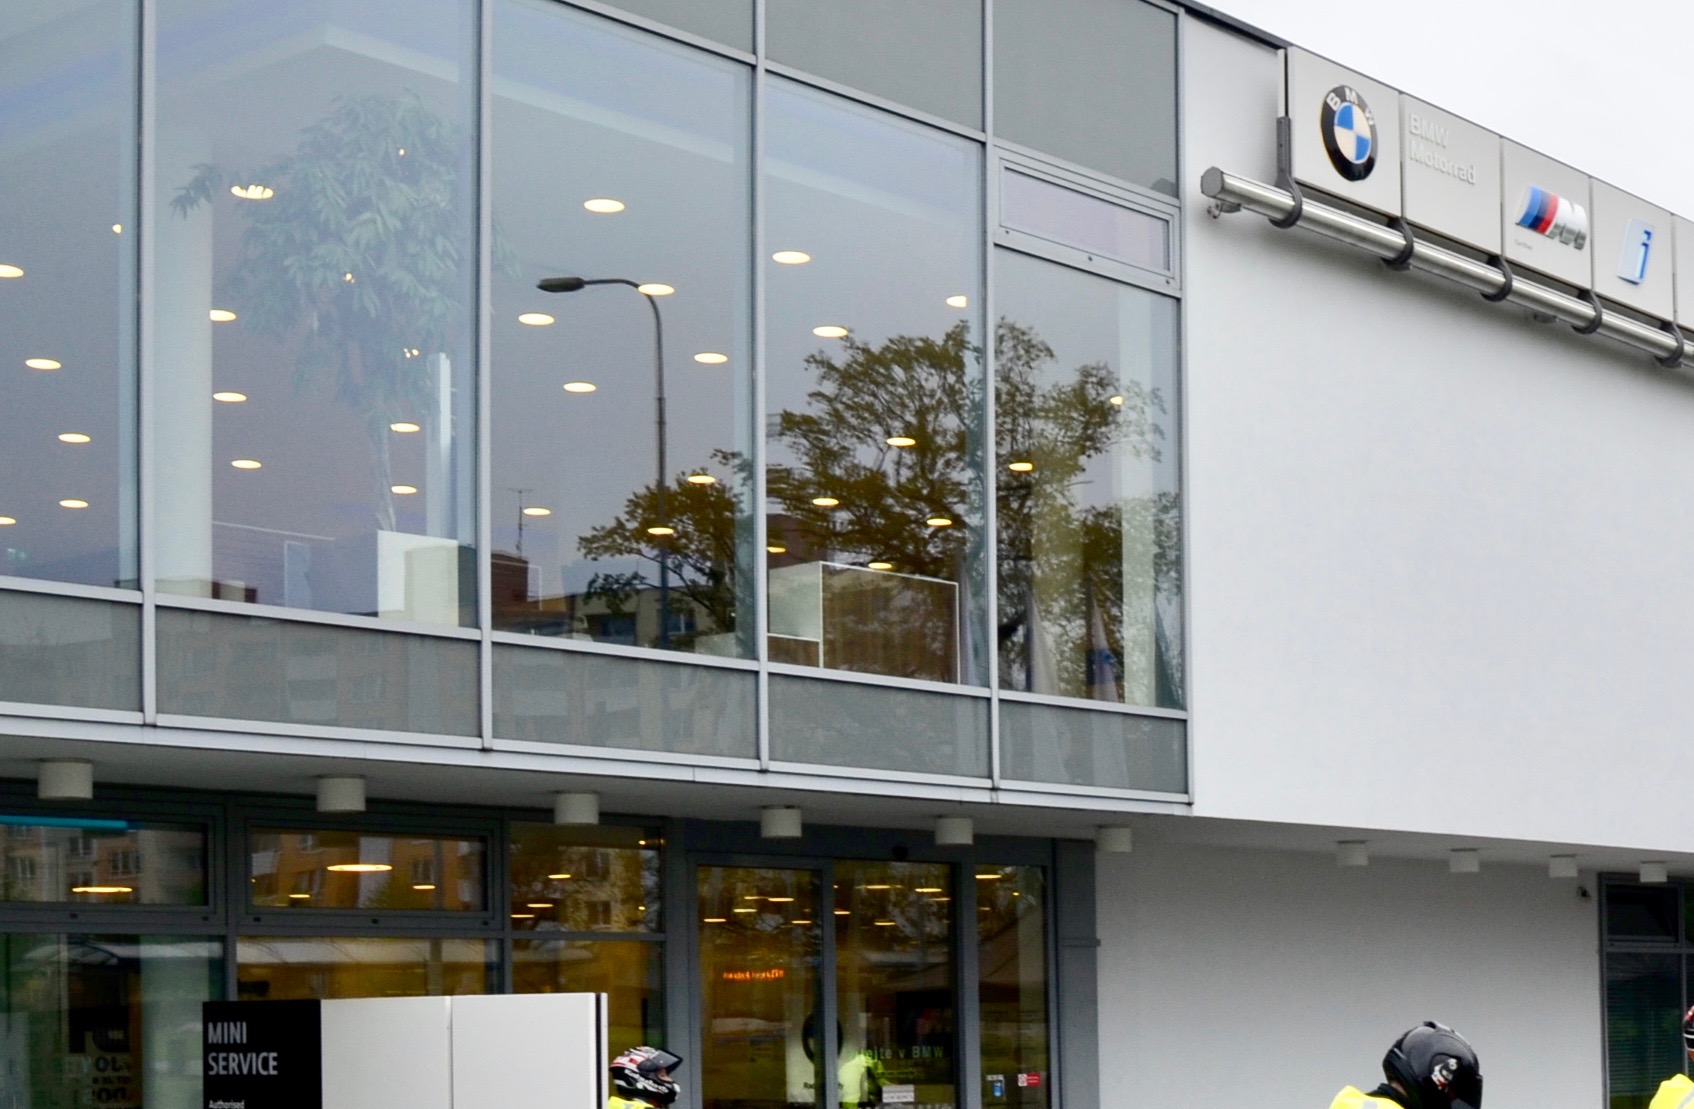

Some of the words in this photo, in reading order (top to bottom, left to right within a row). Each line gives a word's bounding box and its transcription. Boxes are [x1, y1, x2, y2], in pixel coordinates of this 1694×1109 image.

[1409, 114, 1450, 148] BMW
[1409, 140, 1476, 185] Motorrad
[208, 1021, 247, 1044] MINI
[208, 1052, 278, 1075] SERVICE
[912, 1045, 944, 1059] BMW
[209, 1100, 245, 1109] Authorised
